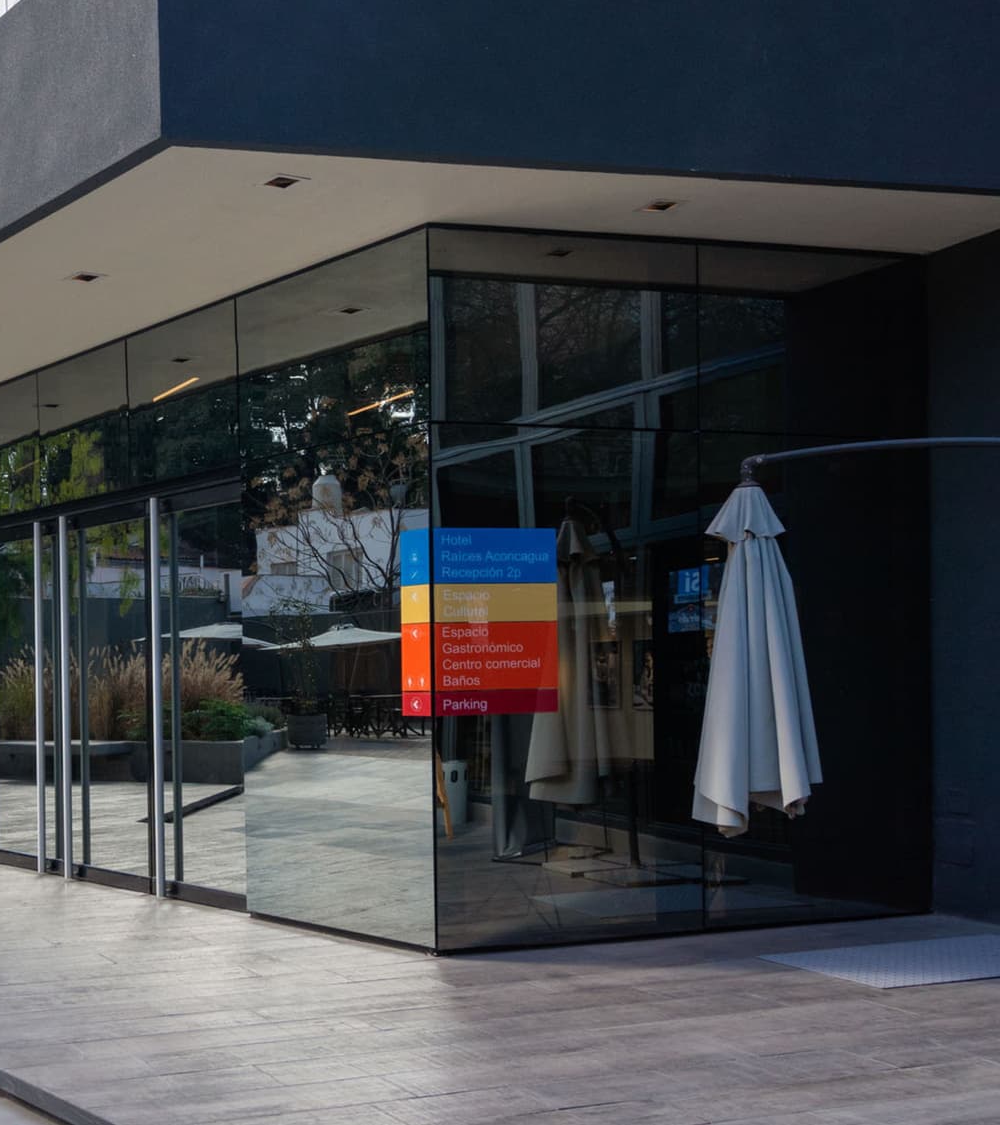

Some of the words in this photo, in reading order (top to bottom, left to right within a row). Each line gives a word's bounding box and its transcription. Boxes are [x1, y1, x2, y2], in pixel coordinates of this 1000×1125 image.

[441, 534, 472, 545] Hotel
[485, 550, 549, 564] Aconcagua
[441, 566, 503, 580] Recepción
[507, 566, 522, 579] 2p
[442, 588, 490, 602] Espacio
[443, 605, 489, 618] Cultural
[442, 626, 489, 640] Espacio
[442, 642, 524, 654] Gastronómico
[442, 659, 482, 670] Centro
[485, 657, 541, 669] comercial
[443, 675, 481, 687] Baños
[443, 698, 488, 711] Parking
